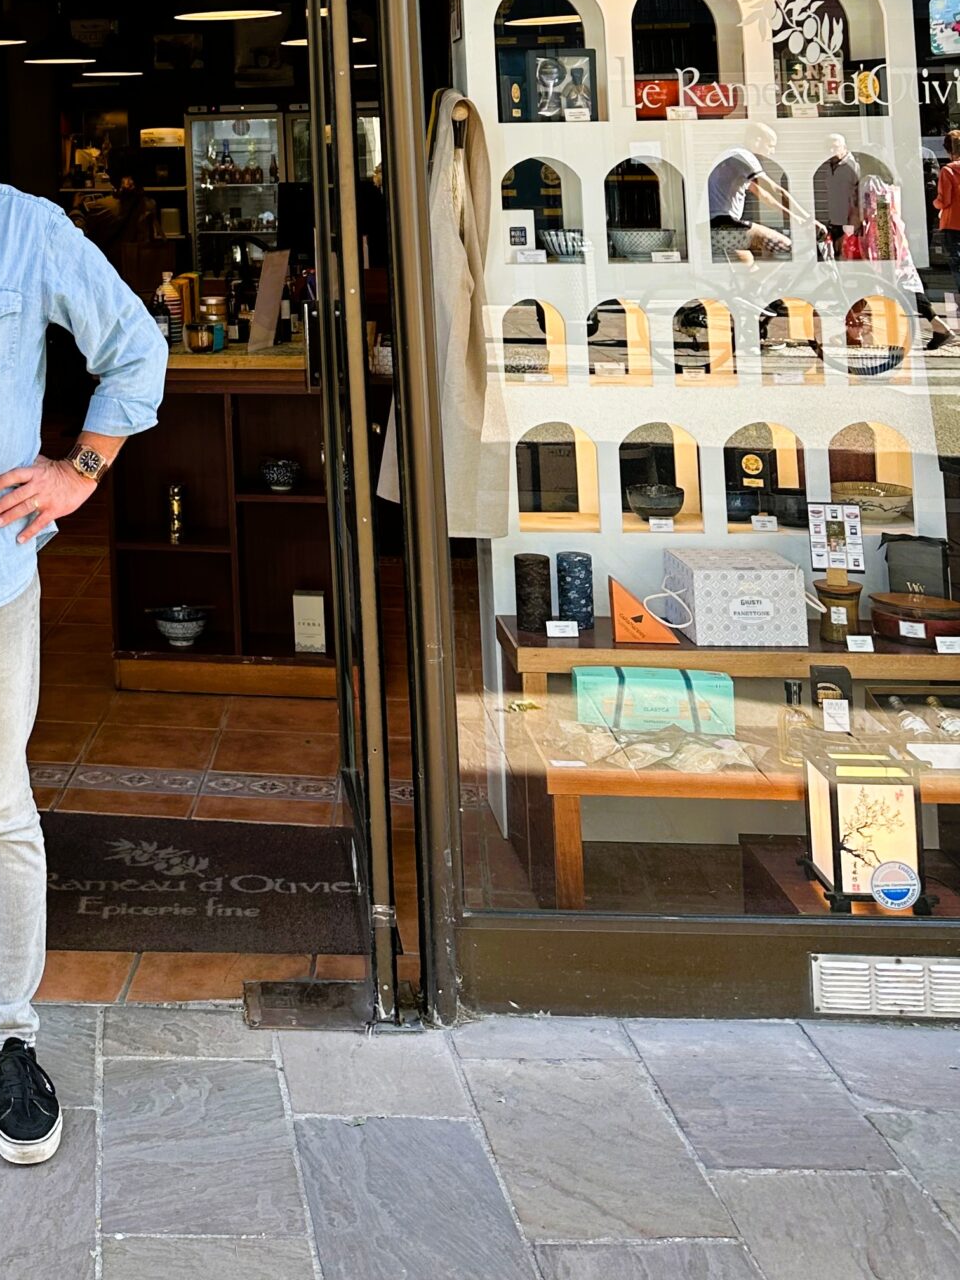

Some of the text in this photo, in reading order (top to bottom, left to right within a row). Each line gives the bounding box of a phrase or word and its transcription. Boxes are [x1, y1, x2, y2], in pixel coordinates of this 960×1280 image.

[614, 56, 662, 109] Le
[675, 66, 825, 108] Rameau
[198, 873, 366, 894] d'Olivie
[77, 896, 261, 920] Epicerie fine
